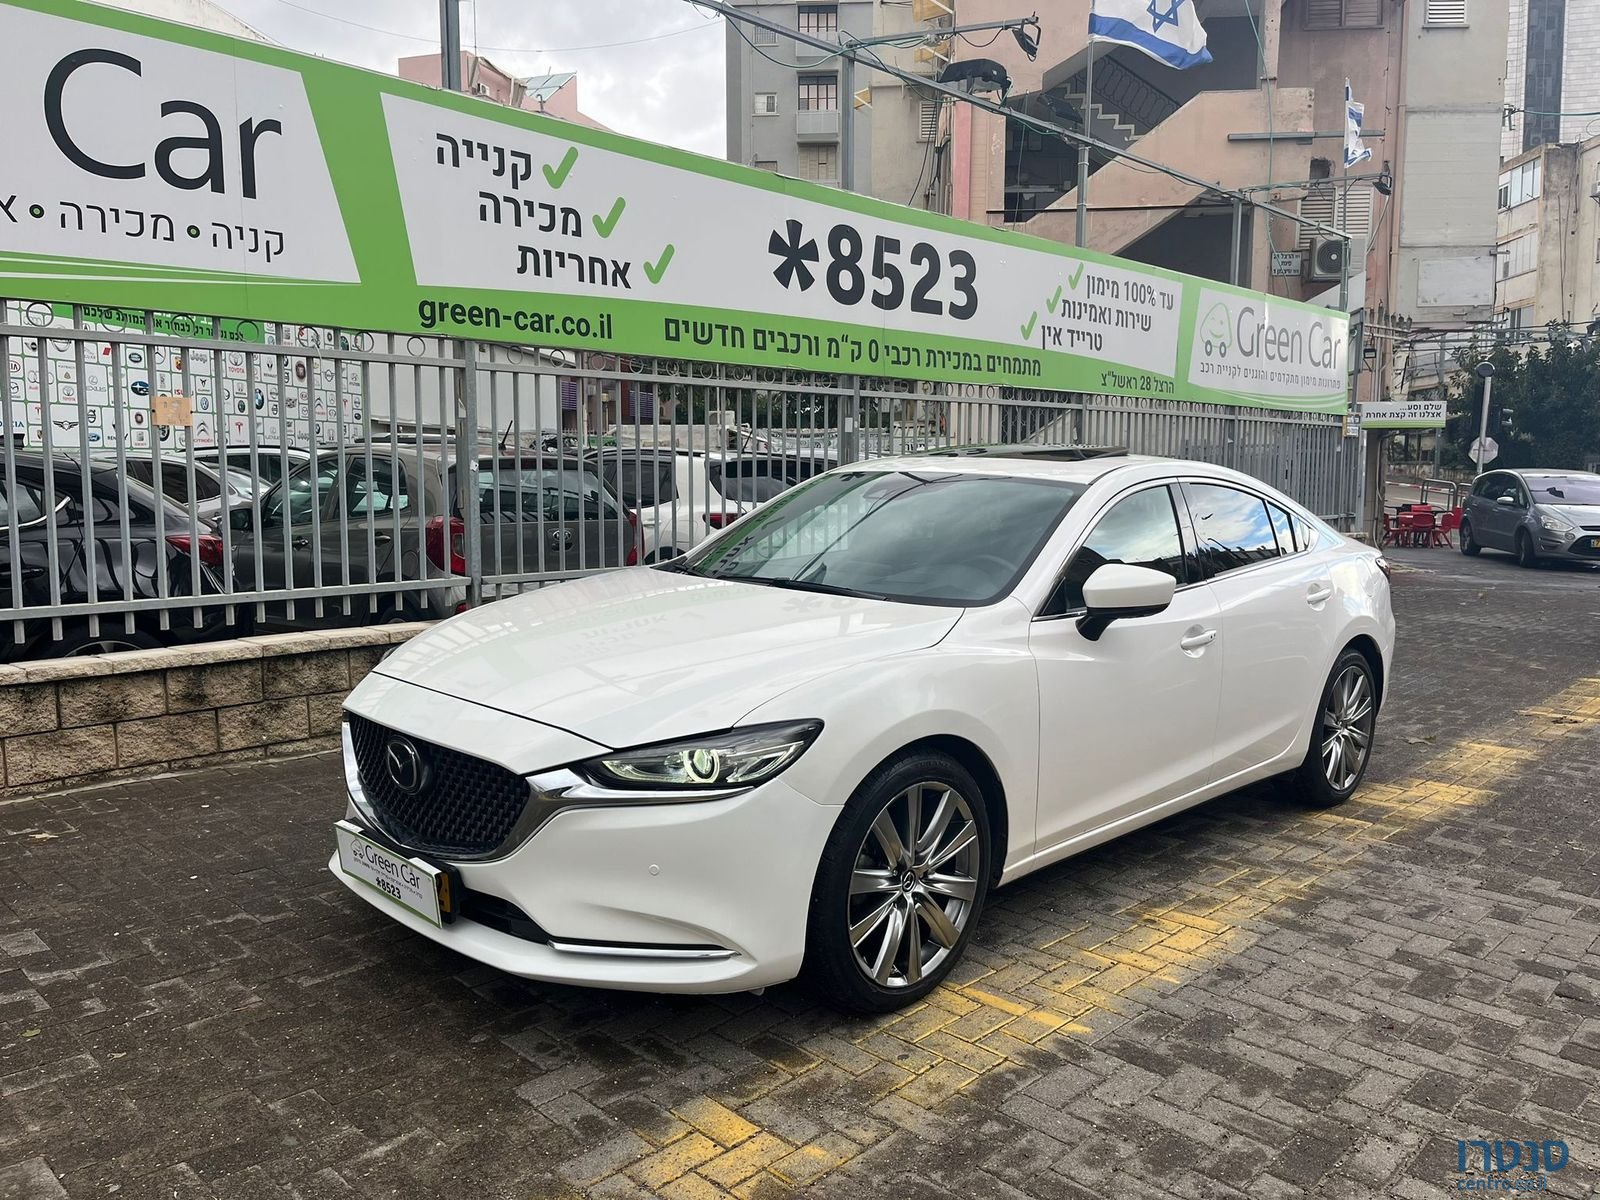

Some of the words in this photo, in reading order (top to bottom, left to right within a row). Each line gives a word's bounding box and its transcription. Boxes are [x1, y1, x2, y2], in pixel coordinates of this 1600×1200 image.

[44, 48, 282, 199] Car
[436, 133, 532, 190] קנייה
[60, 201, 175, 241] מכירה
[479, 191, 582, 237] מכירה
[212, 222, 284, 262] קניה
[517, 245, 631, 289] אחריות
[1086, 274, 1119, 299] מימון
[1124, 281, 1157, 307] 100%
[1061, 299, 1112, 325] ואמינות
[1159, 292, 1174, 310] עד
[418, 300, 612, 339] green-car.co.il
[1115, 308, 1151, 332] שירות
[665, 318, 745, 349] חדשים
[753, 328, 820, 356] ורכבים
[1041, 324, 1062, 350] אין
[1067, 328, 1103, 351] טרייד
[1237, 306, 1302, 364] Green
[1308, 321, 1341, 369] Car
[868, 343, 879, 364] 0
[885, 345, 921, 368] רכבי
[926, 348, 982, 374] במכירת
[987, 353, 1041, 377] מתמחים
[1200, 362, 1214, 374] רכב
[1140, 375, 1151, 391] 28
[1154, 377, 1175, 394] הרצל
[1389, 411, 1406, 419] קצת
[365, 845, 399, 877] Green
[401, 864, 420, 889] Car
